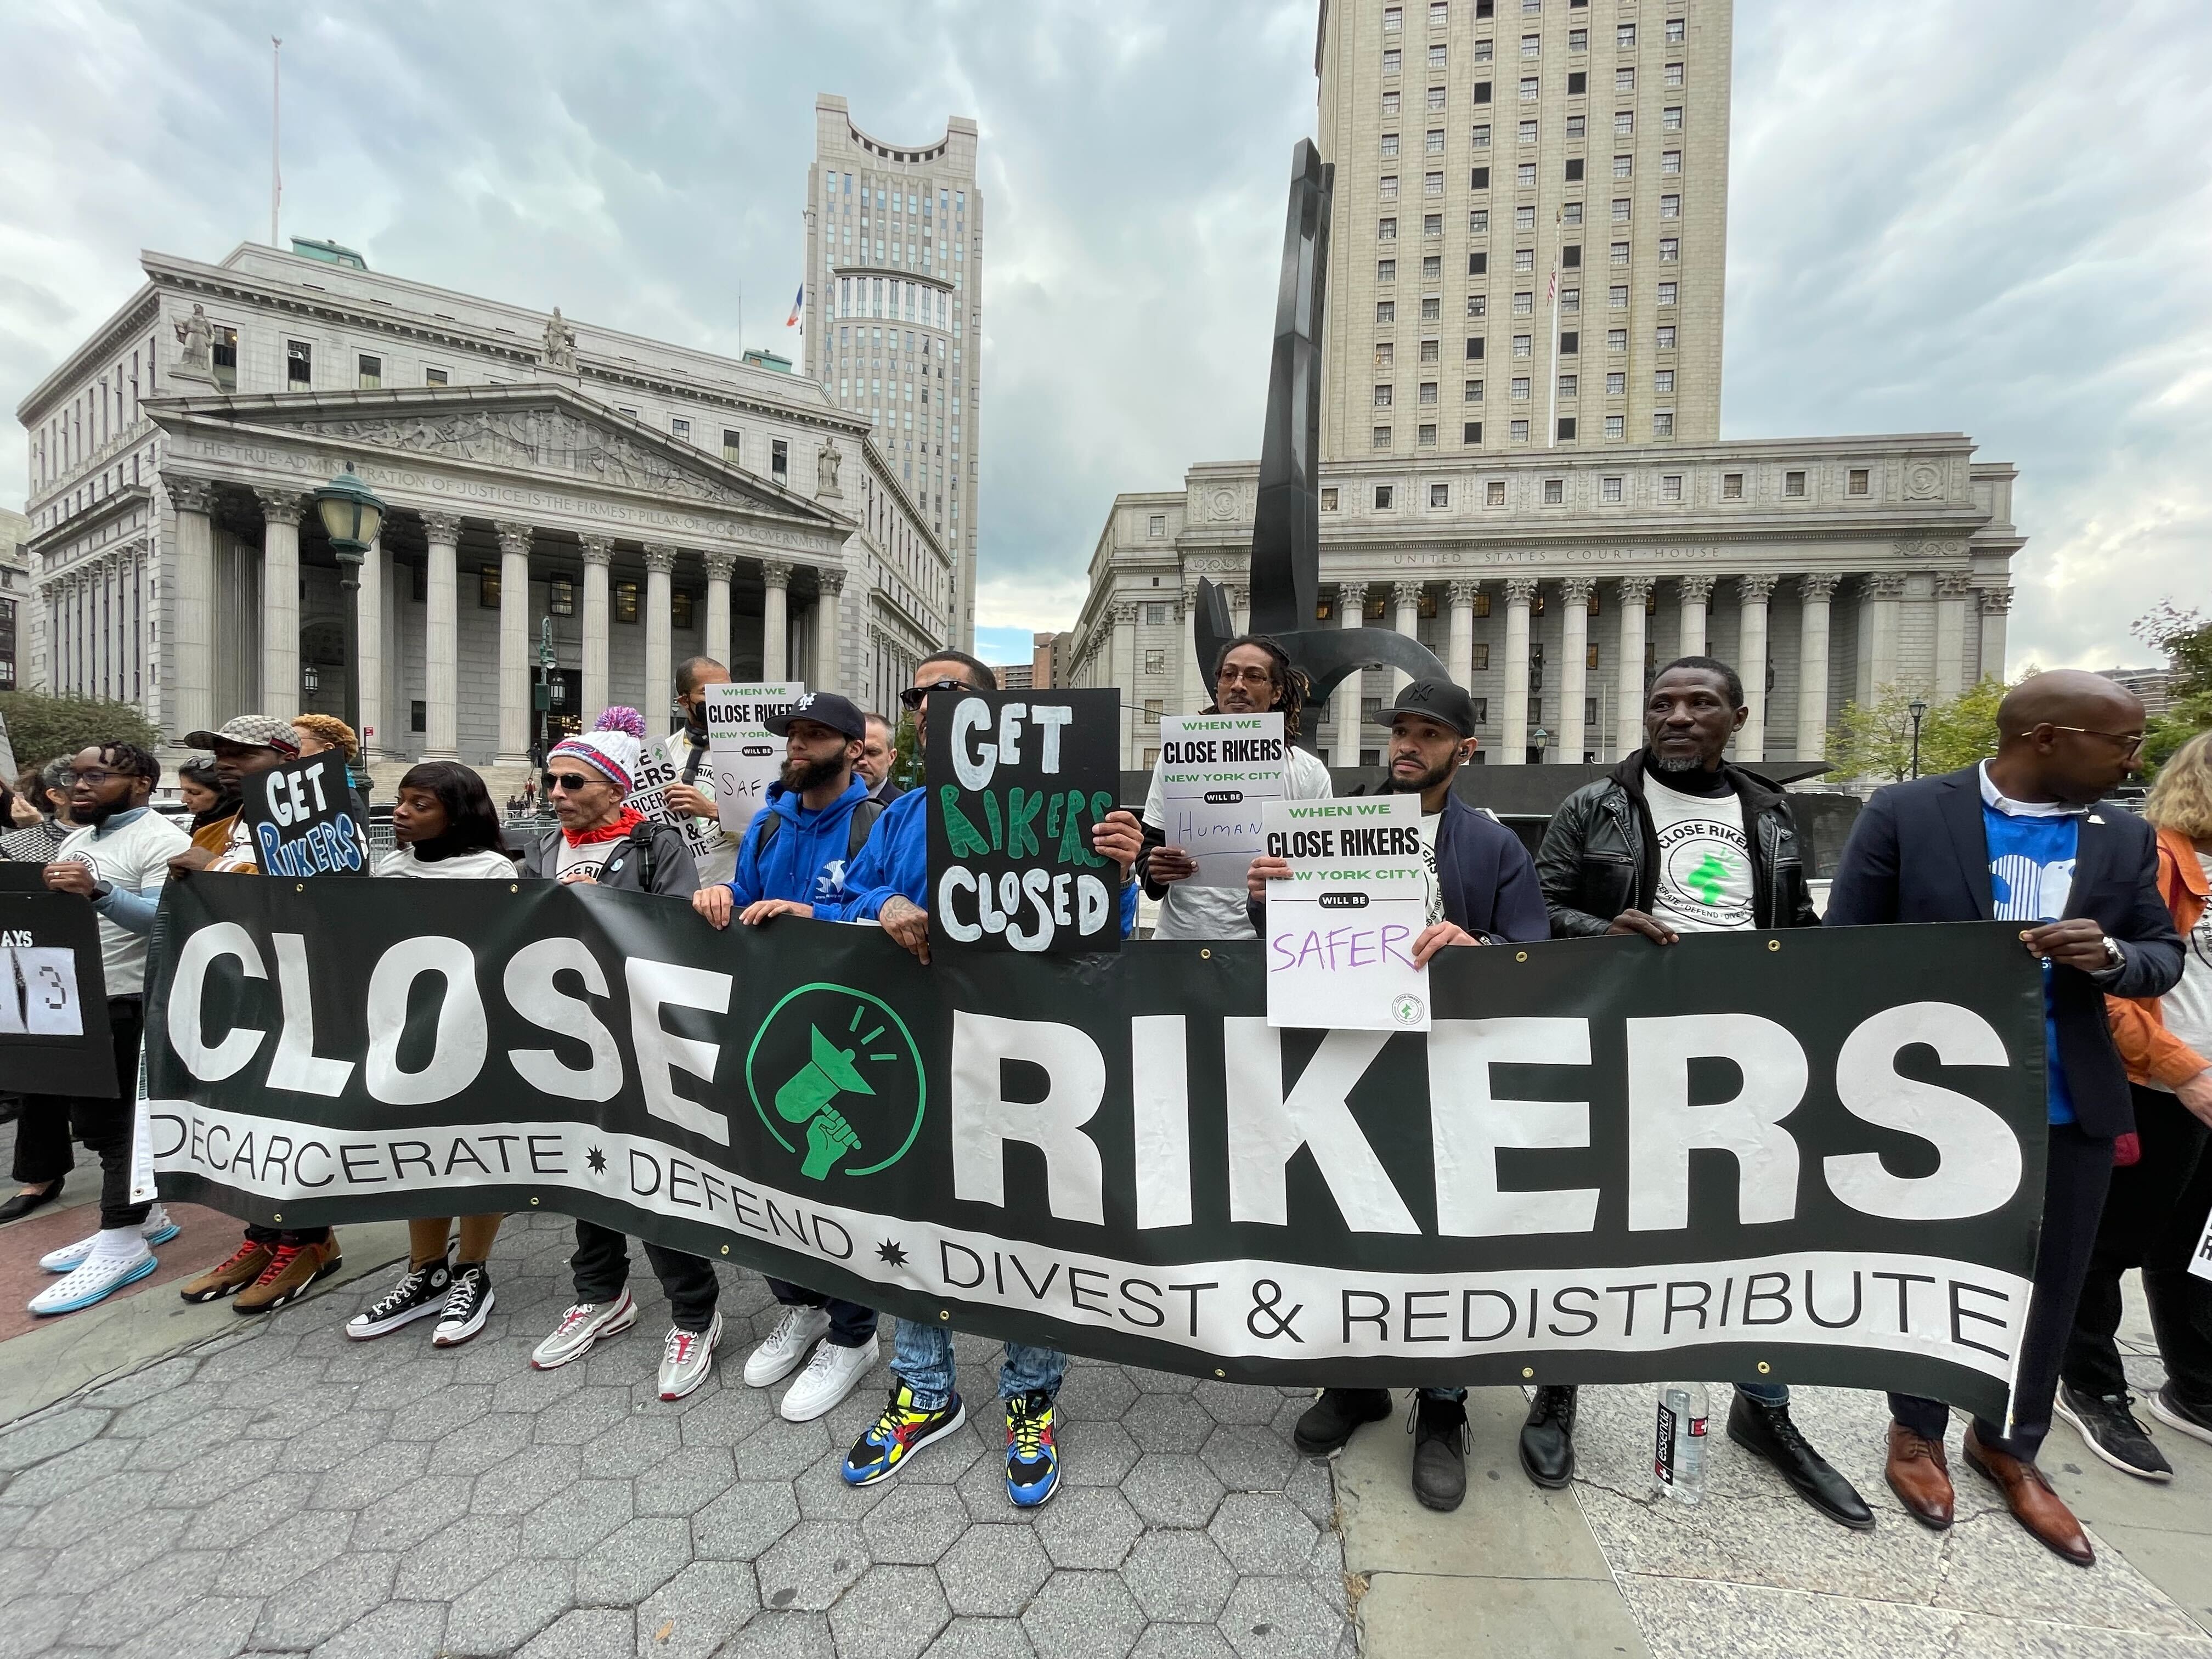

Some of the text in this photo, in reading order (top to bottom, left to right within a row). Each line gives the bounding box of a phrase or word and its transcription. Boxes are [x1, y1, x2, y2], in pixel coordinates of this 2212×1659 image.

[192, 441, 833, 550] THE TRUE ADMINTRATION OF JUSTICE IS THE FIRMEST PILLAR OF GOOD GOVERNMENT
[1393, 548, 1720, 564] UNITED STATES COURT HOUSE
[708, 704, 794, 723] CLOSE RIKER
[1182, 720, 1262, 730] WHEN WE
[951, 697, 1073, 792] GET
[1164, 738, 1282, 764] CLOSE RIKERS
[721, 772, 761, 798] SAF
[1165, 771, 1282, 782] NEW YORK CITY
[266, 762, 328, 827] GET
[1289, 804, 1391, 819] WHEN WE
[940, 784, 1113, 868] RIKERS
[1659, 824, 1749, 850] CLOSE RIKE
[256, 812, 363, 877] RIKERS
[1267, 827, 1420, 858] CLOSE RIKERS
[1317, 870, 1372, 881] YORK
[1375, 869, 1420, 879] CITY
[938, 865, 1110, 952] CLOSED
[1684, 905, 1719, 918] DEFEND
[1, 930, 33, 947] AYS
[1271, 924, 1420, 973] SAFER
[168, 921, 2023, 1237] CLOSE RIKERS
[150, 1113, 2010, 1361] DECARCERATE DEFEND DIVEST & REDISTRIBUTE
[1658, 1408, 1669, 1462] essentia
